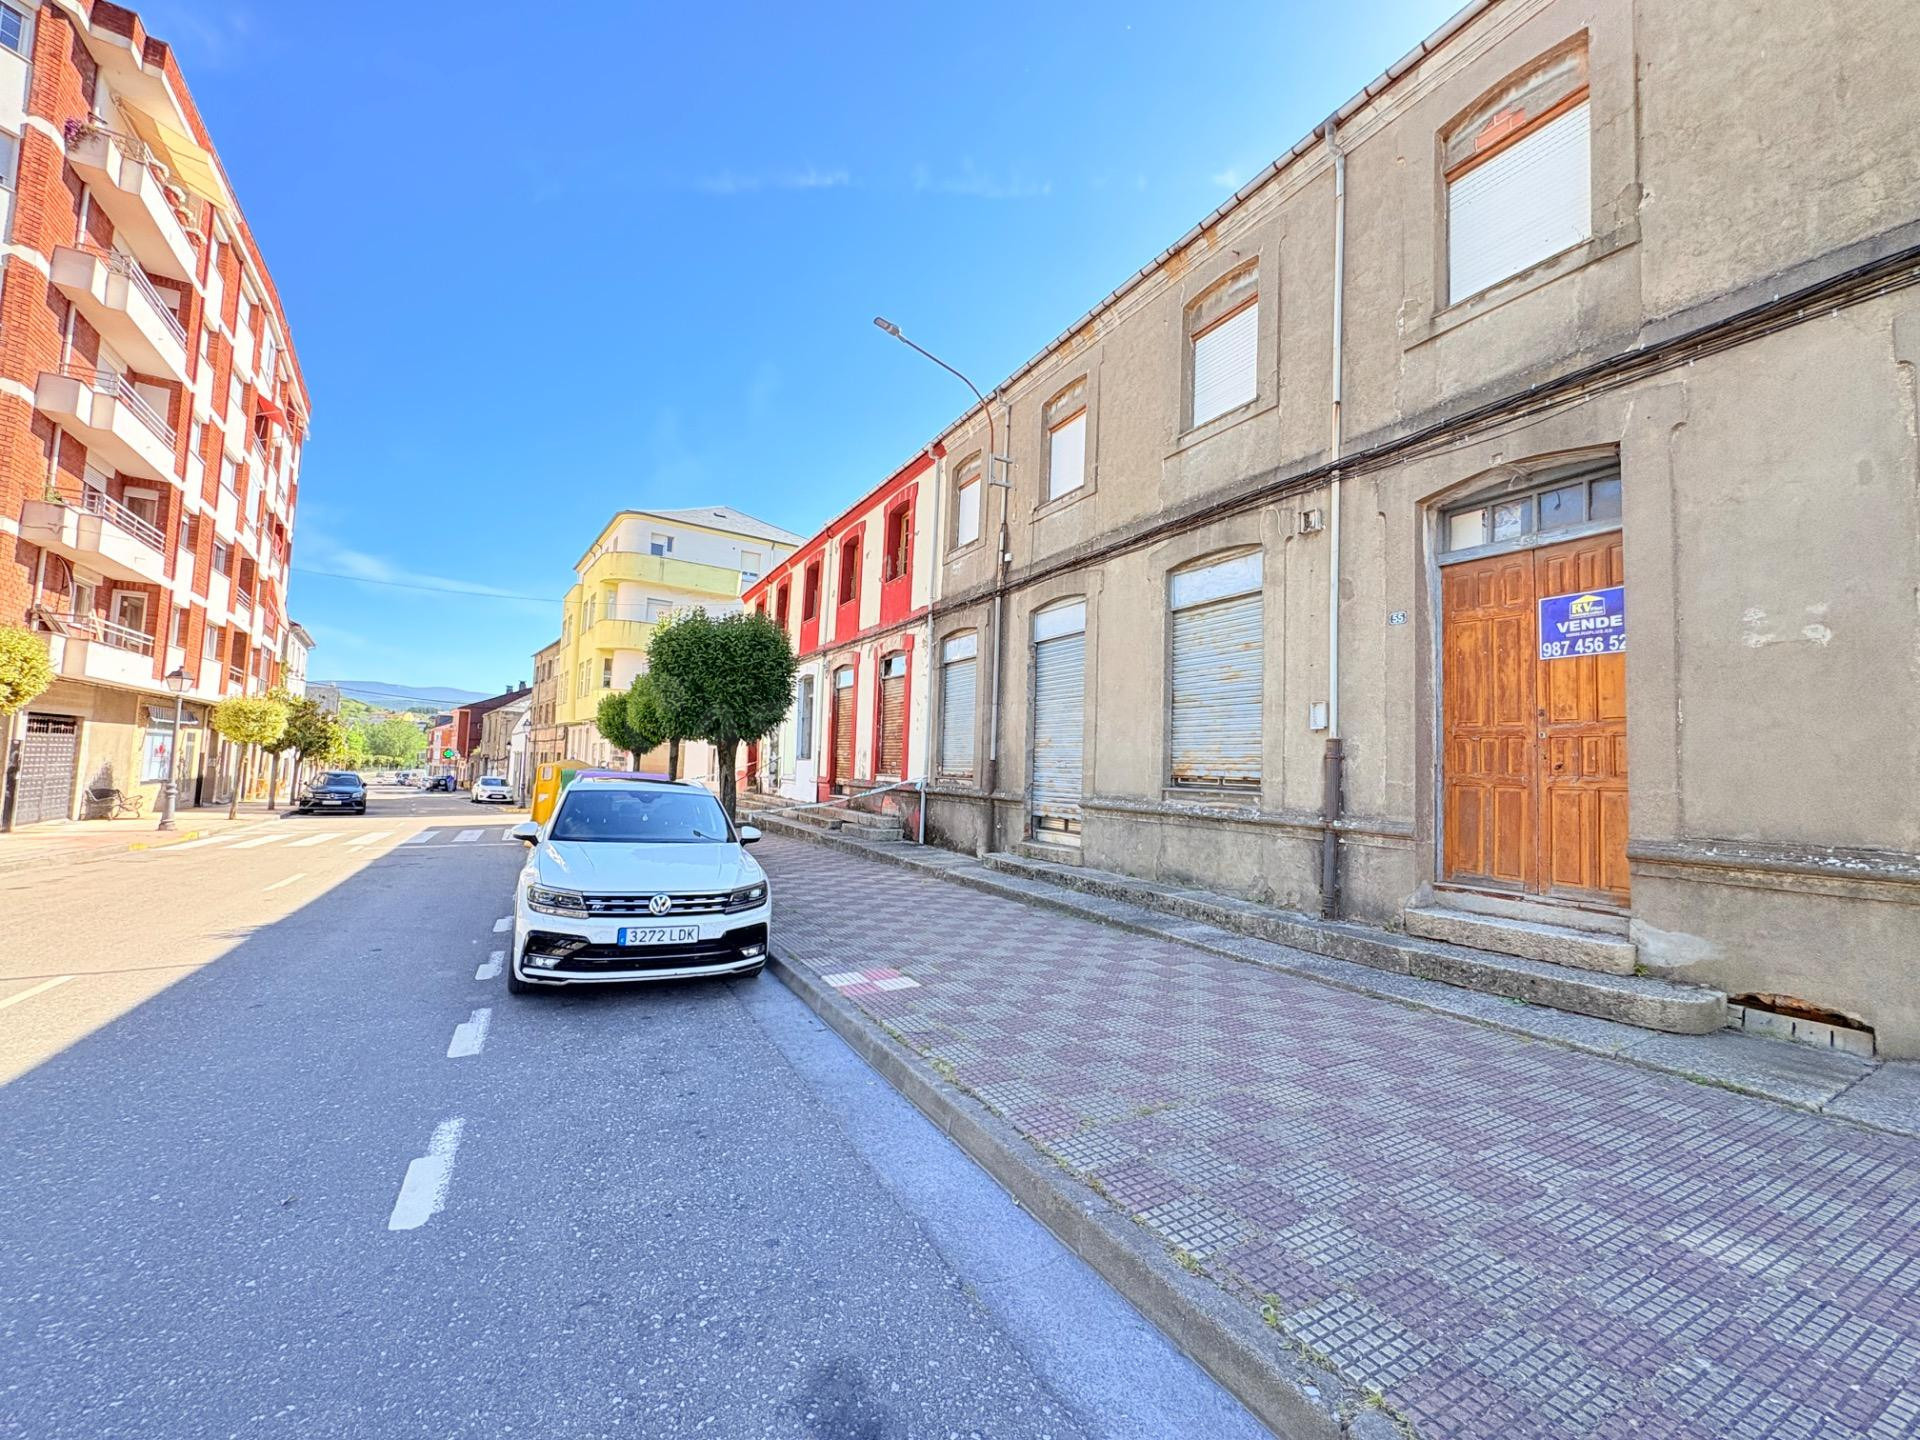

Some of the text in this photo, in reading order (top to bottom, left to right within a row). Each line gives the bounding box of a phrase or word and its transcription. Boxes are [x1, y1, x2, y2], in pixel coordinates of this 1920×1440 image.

[1391, 612, 1404, 624] 55
[1556, 615, 1623, 633] VENDE
[1542, 640, 1570, 658] 987
[1574, 636, 1605, 654] 456
[629, 928, 695, 943] 3272 LDK
